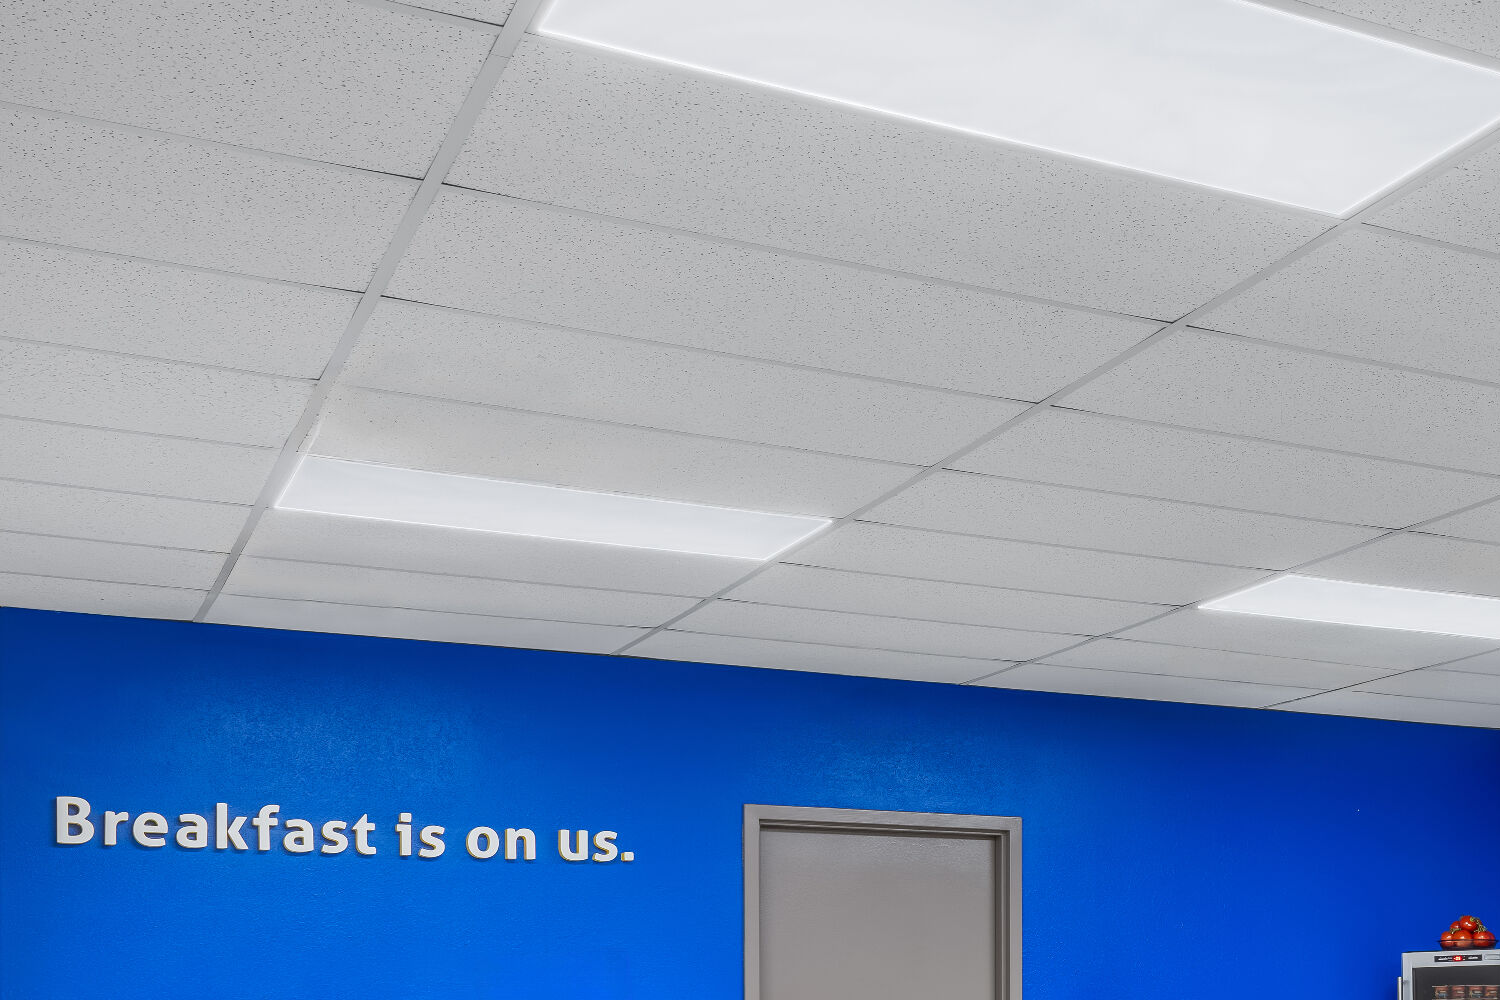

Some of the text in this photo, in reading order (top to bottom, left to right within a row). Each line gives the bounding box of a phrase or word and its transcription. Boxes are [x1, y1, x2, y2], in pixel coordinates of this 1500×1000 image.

[55, 795, 636, 863] Breakfast is on us.
